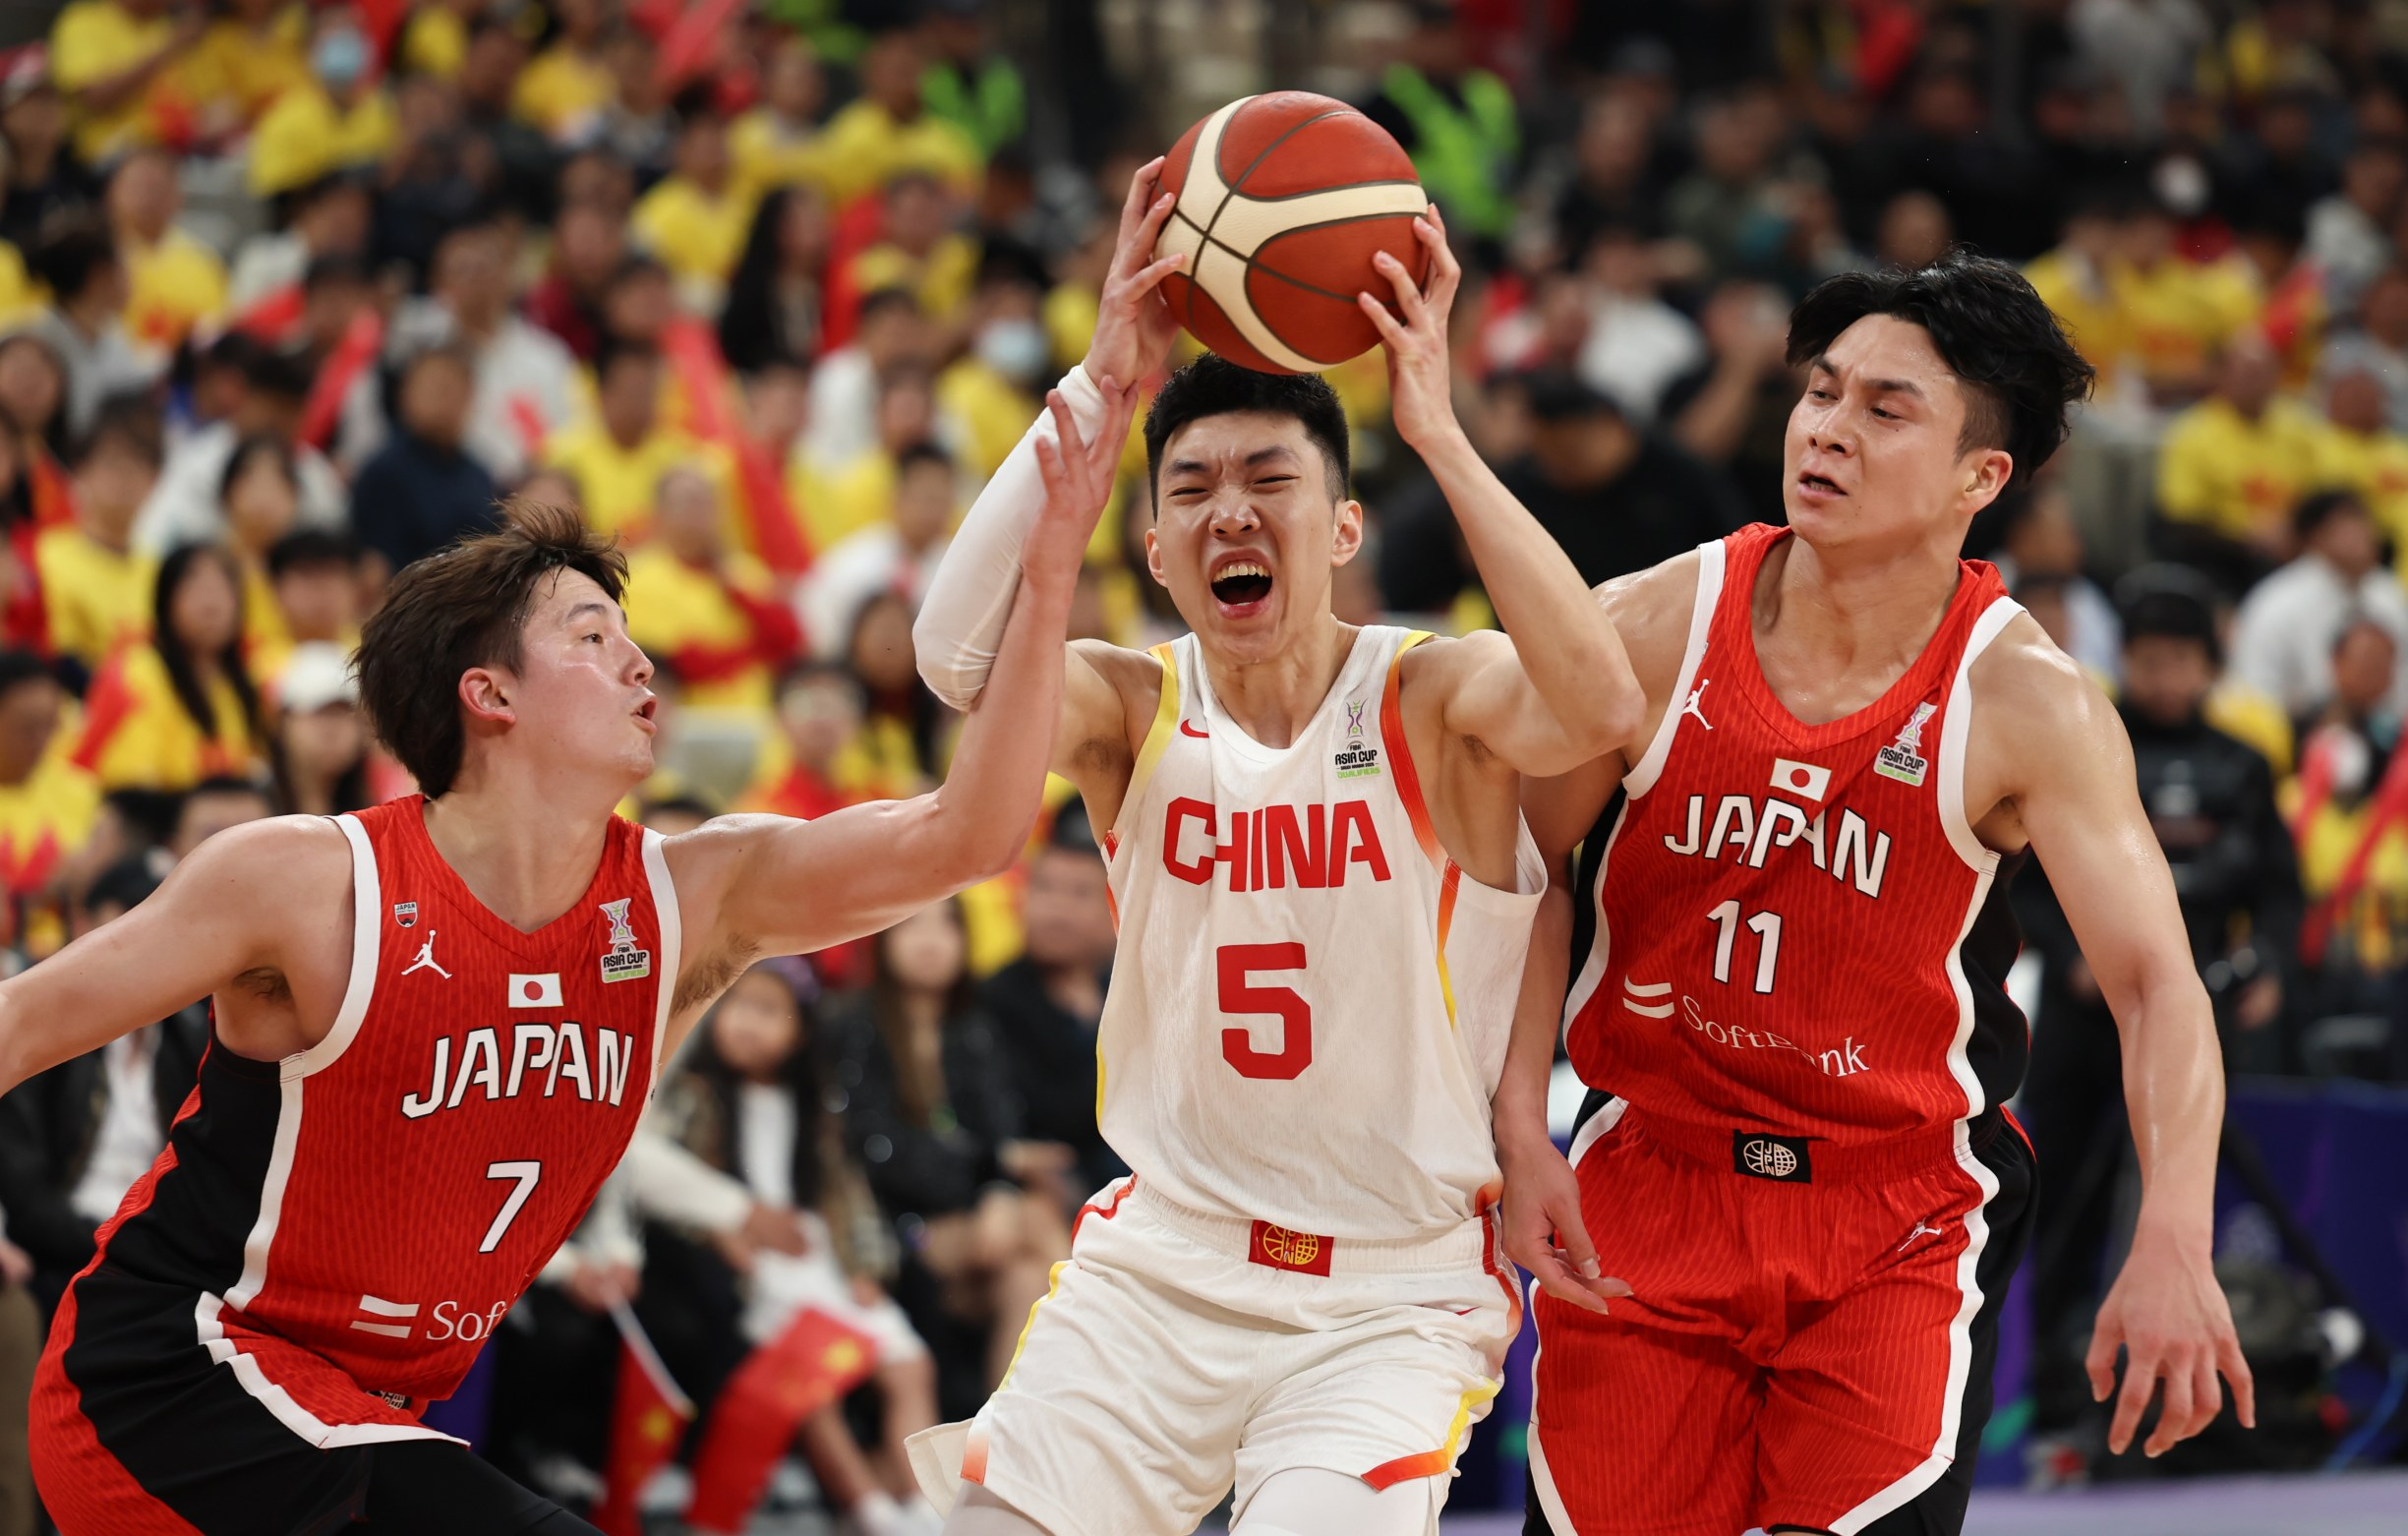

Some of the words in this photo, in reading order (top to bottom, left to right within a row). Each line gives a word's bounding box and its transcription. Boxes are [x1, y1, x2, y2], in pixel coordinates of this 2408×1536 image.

[1335, 752, 1357, 765] ASIA
[1358, 749, 1378, 762] CUP
[1880, 747, 1904, 764] ASIA
[1904, 756, 1924, 770] CUP
[1163, 797, 1391, 892] CHINA
[1664, 796, 1891, 899] JAPAN
[603, 954, 625, 968] ASIA
[627, 952, 647, 964] CUP
[1706, 900, 1782, 993] 11
[1216, 942, 1312, 1080] 5
[401, 1023, 633, 1119] JAPAN
[1764, 1142, 1776, 1176] JPN
[478, 1160, 542, 1254] 7
